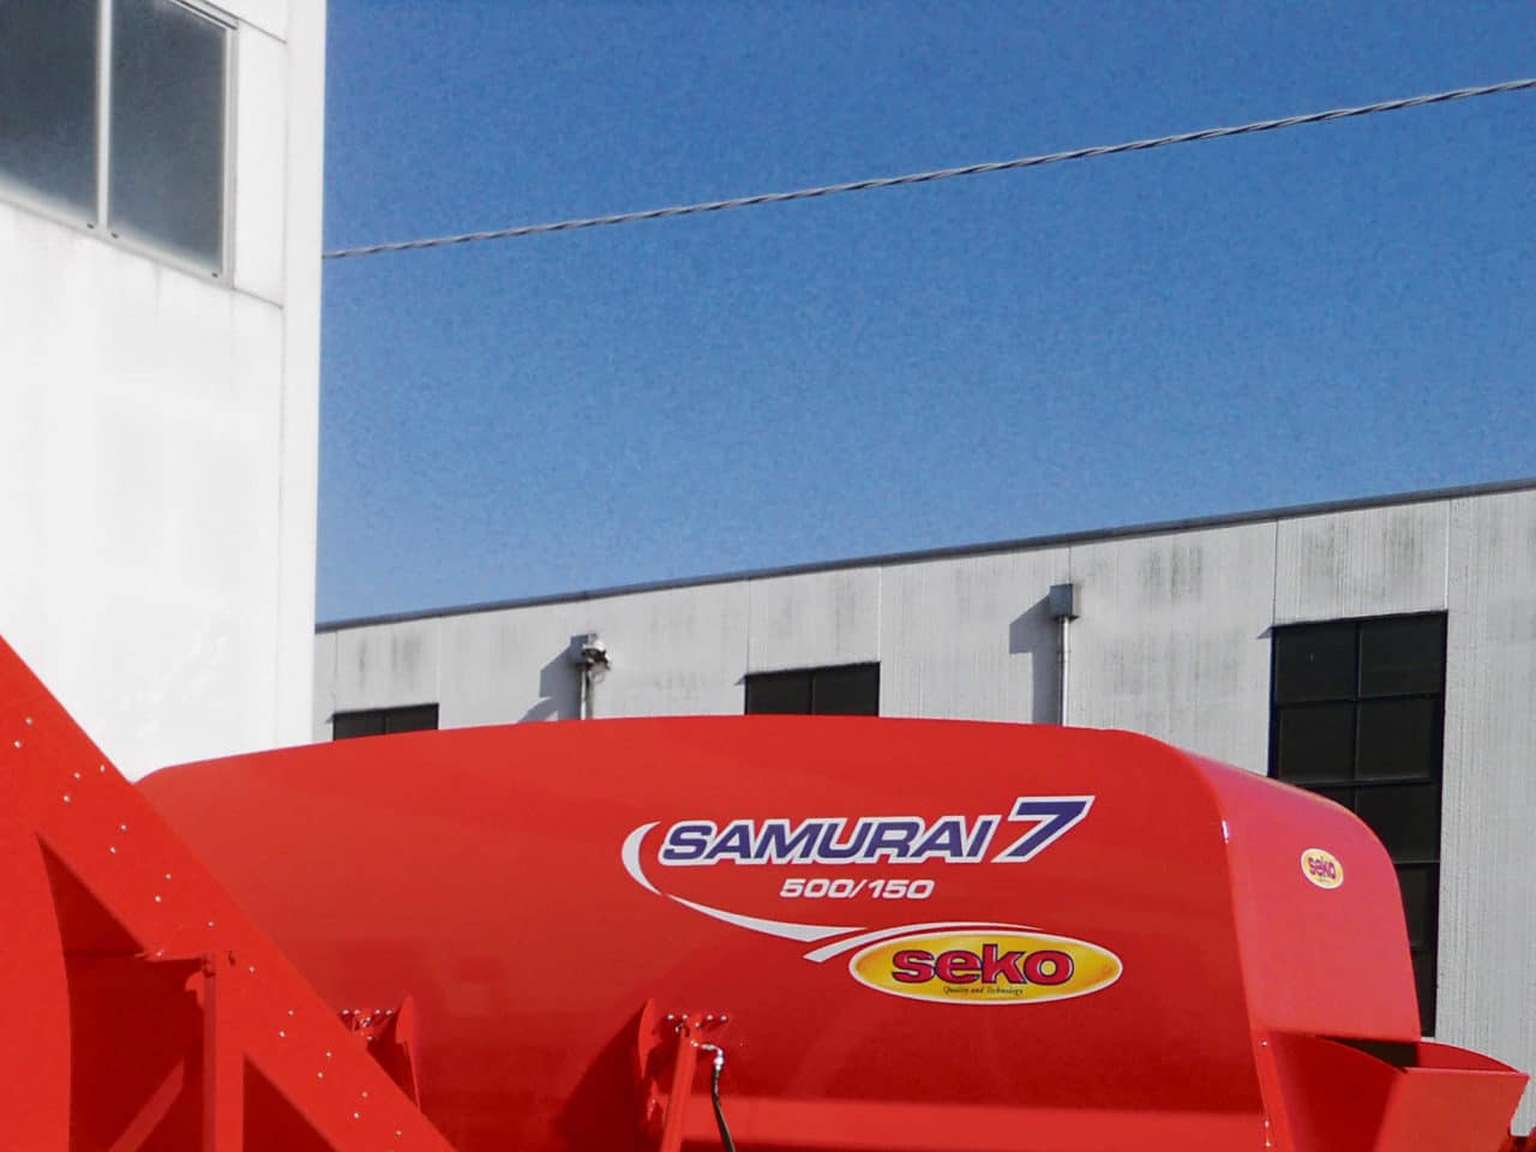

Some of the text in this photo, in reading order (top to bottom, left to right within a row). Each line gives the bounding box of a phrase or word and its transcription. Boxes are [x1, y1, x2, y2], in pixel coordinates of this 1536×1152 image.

[659, 795, 1095, 866] SAMURAI 7
[779, 878, 935, 900] 500/150
[891, 943, 1075, 986] seko
